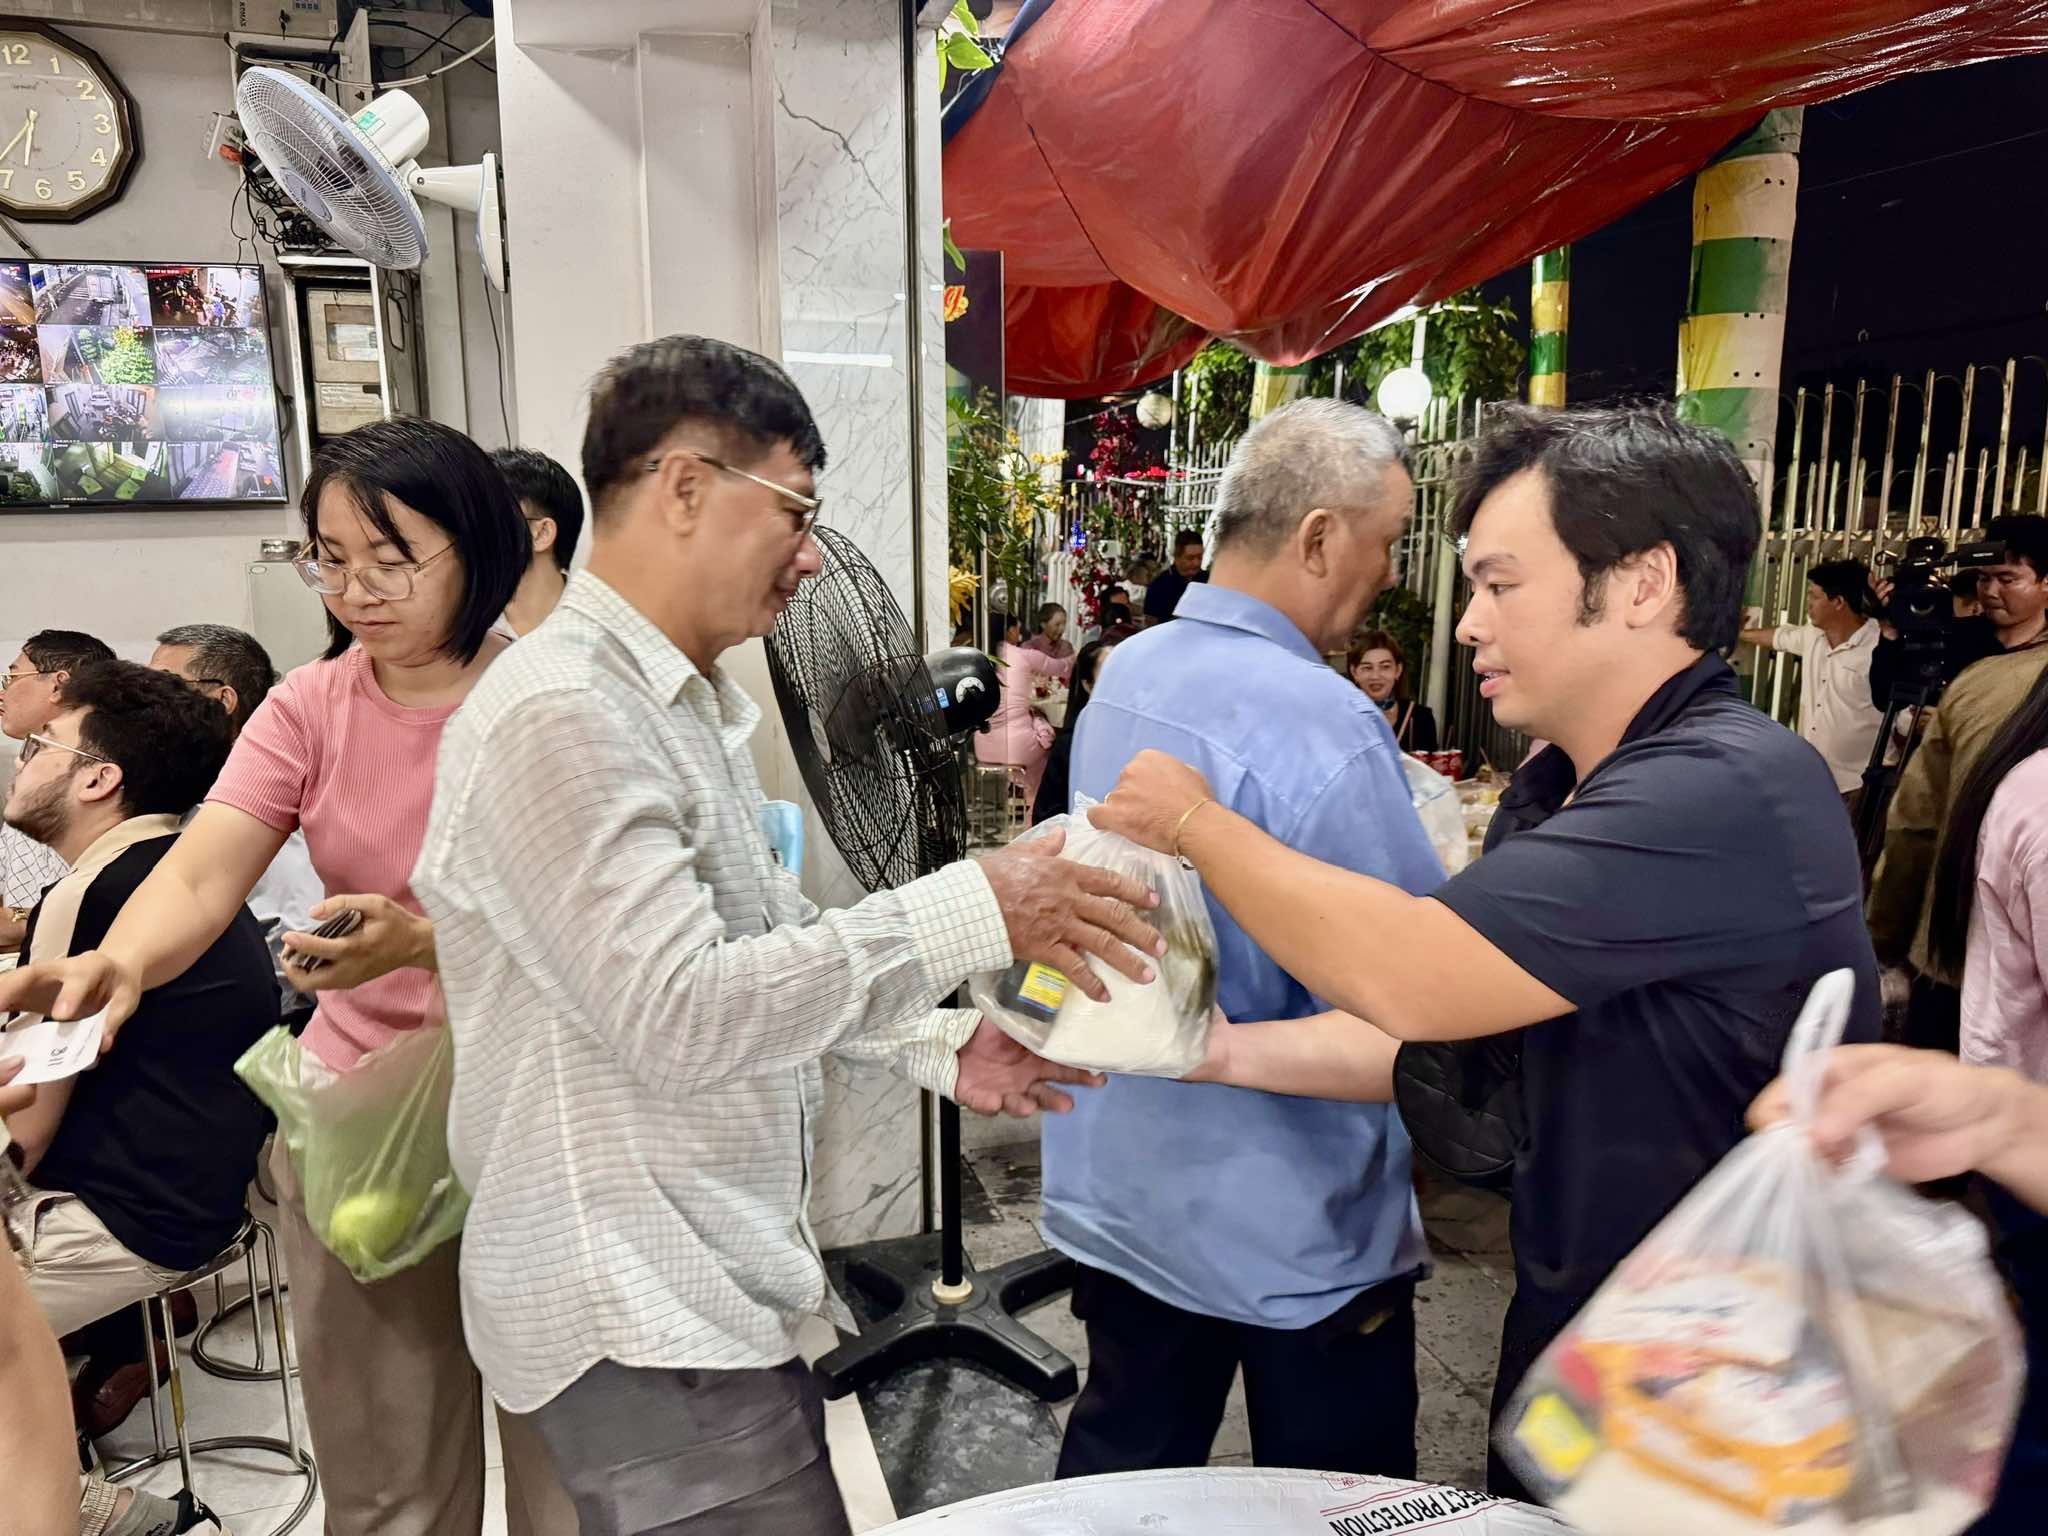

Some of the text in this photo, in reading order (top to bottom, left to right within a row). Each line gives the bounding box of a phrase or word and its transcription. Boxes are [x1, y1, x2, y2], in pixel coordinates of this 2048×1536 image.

[2, 44, 32, 65] 12
[50, 56, 61, 74] 1
[77, 79, 97, 100] 2
[93, 113, 112, 134] 3
[90, 147, 108, 167] 4
[0, 169, 14, 190] 7
[34, 178, 52, 199] 6
[67, 170, 86, 191] 5
[1329, 1494, 1447, 1536] PROTECTION
